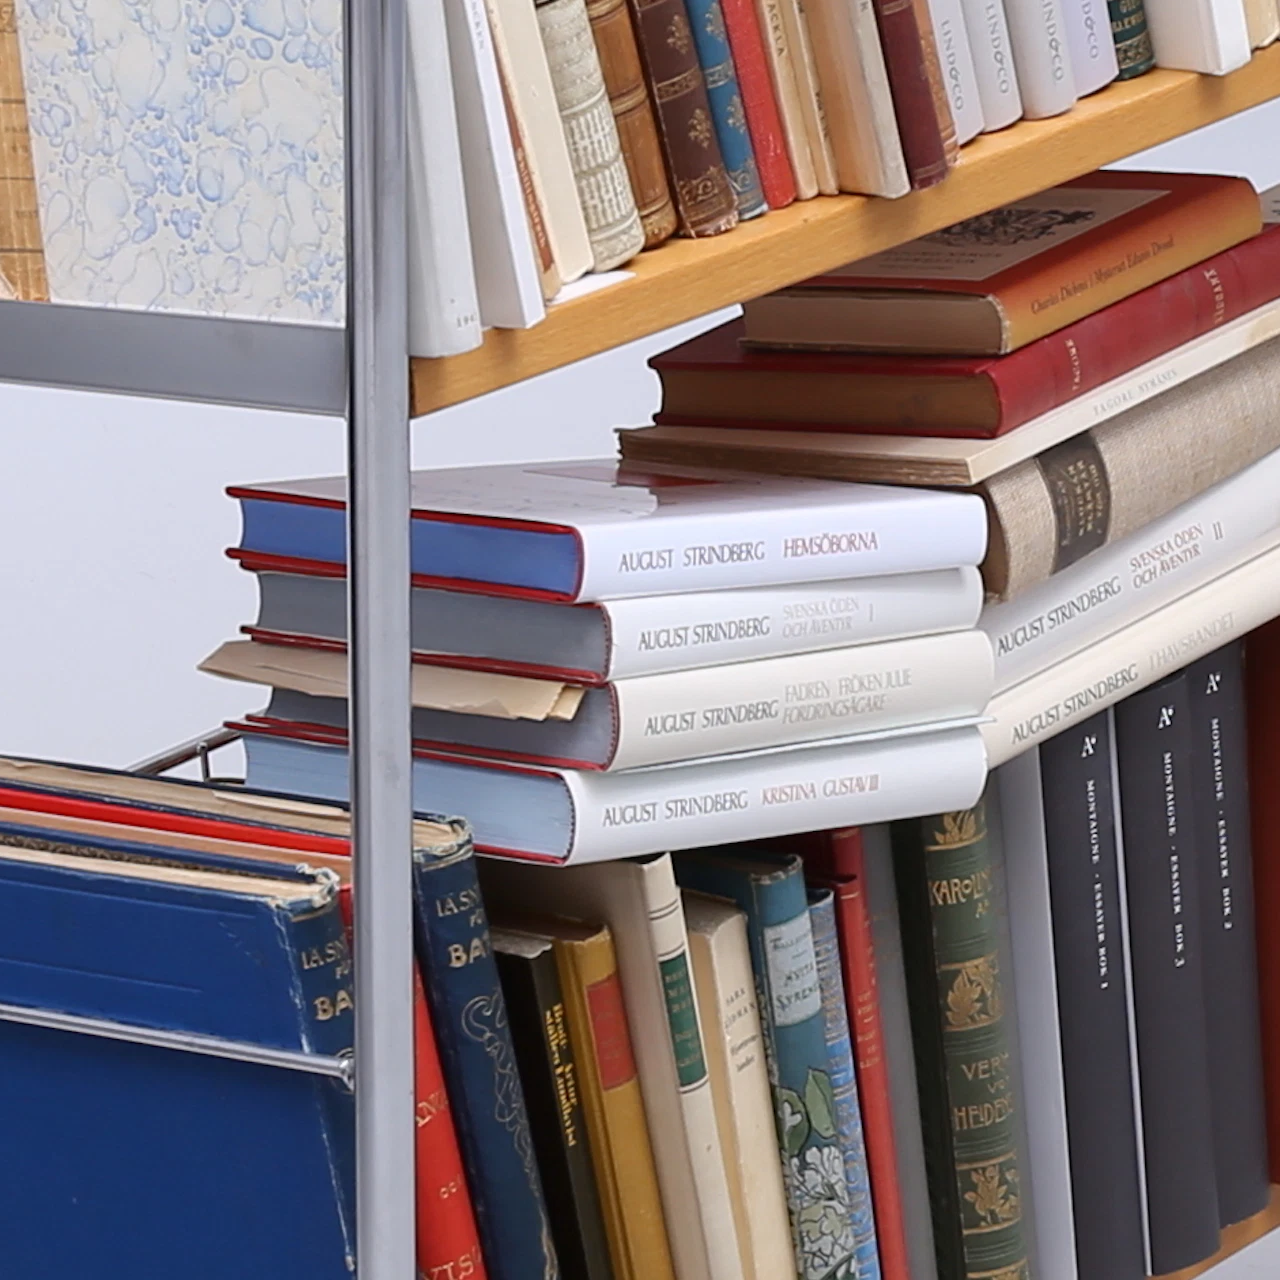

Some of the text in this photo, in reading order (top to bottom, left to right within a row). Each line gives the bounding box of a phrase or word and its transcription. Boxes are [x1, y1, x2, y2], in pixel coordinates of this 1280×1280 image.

[940, 19, 965, 112] LIND&CO
[984, 2, 1010, 95] LIND&CO
[1093, 384, 1134, 418] TAGORE
[618, 531, 879, 573] AUGUST STRINDBERG HEMSÖBORNA
[1128, 522, 1205, 573] SVENSKA ÖDEN
[1132, 544, 1202, 589] OCH ÄVENTYR
[782, 595, 860, 620] SVENSKA ÖDEN
[996, 521, 1224, 658] AUGUST STRINDBERG II
[638, 626, 690, 652] AUGUST
[692, 615, 772, 644] STRINDBERG
[781, 621, 808, 639] OCH
[784, 668, 913, 704] FADREN FRÖKEN JULIE
[1011, 662, 1140, 746] AUGUST STRINDBERG
[644, 699, 780, 737] AUGUST STRINDBERG
[1211, 717, 1225, 802] MONTAIGNE
[602, 802, 658, 827] AUGUST
[664, 789, 750, 819] STRINDBERG
[760, 781, 817, 806] KRISTINA
[822, 776, 868, 798] GUSTAV
[1162, 752, 1178, 837] MONTAIGNE
[1217, 819, 1230, 879] ESSAYER
[1085, 779, 1109, 978] MONTAIGNE ESSAYER BOK
[1169, 854, 1182, 916] ESSAYER
[1222, 887, 1233, 917] BOK
[1174, 923, 1185, 953] BOK
